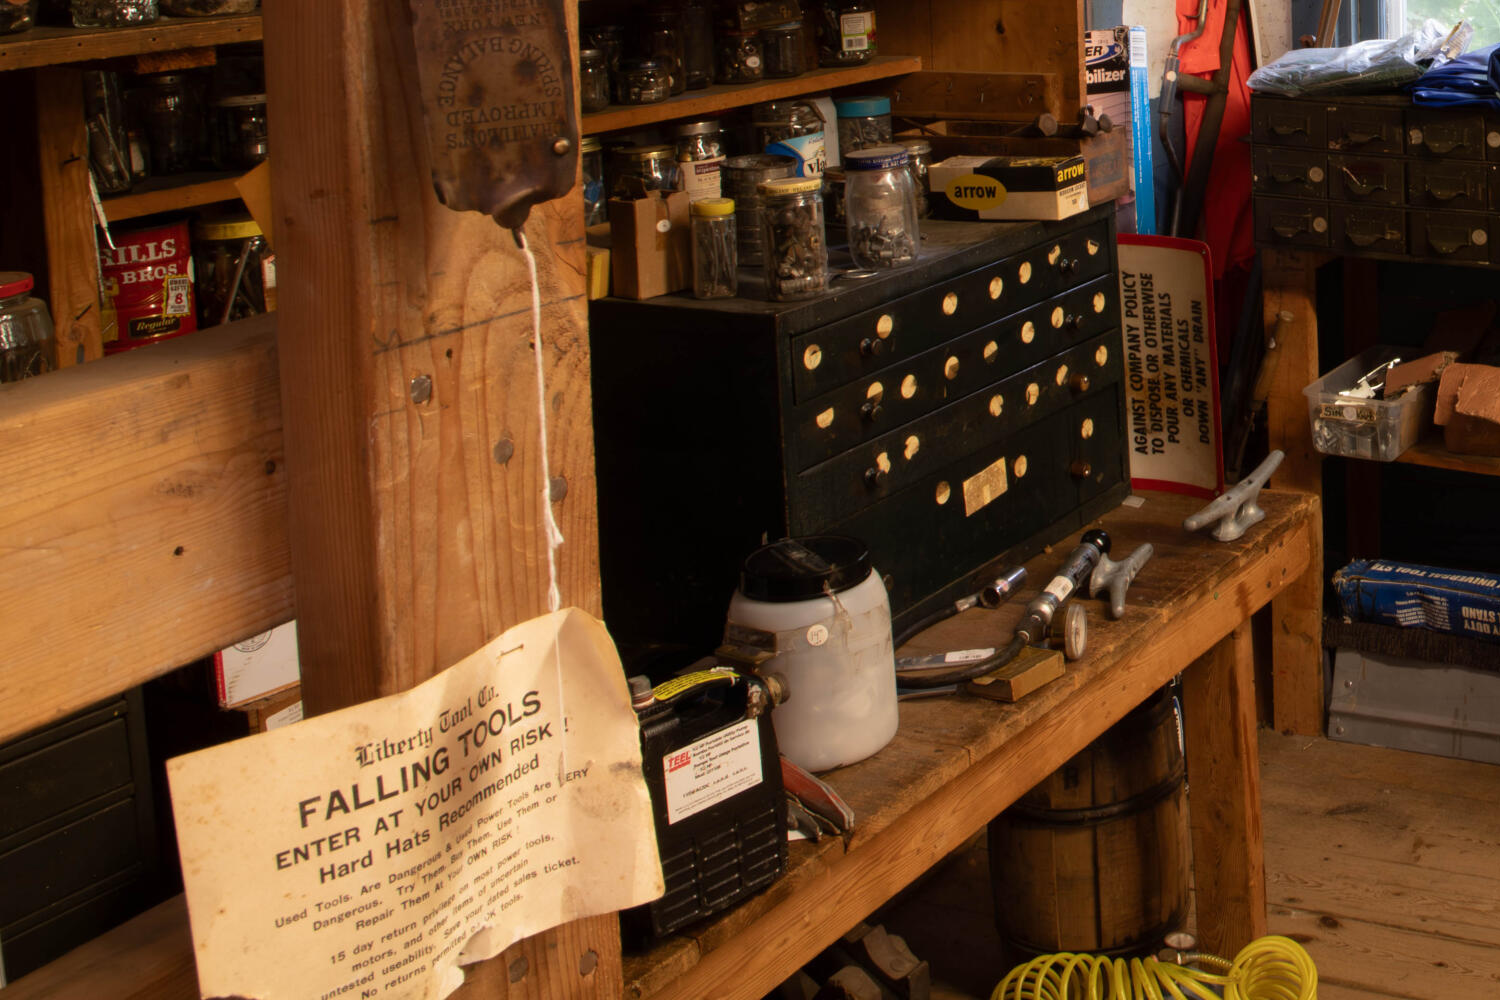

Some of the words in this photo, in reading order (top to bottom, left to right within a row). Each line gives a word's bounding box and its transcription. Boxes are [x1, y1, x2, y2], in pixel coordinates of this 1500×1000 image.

[439, 36, 504, 107] BALANCE
[510, 38, 561, 97] SPRING
[446, 101, 555, 127] IMPROVED
[954, 185, 997, 198] arrow
[1057, 162, 1085, 183] arrow
[121, 264, 178, 284] BROS
[1121, 271, 1138, 320] POLICY
[136, 318, 176, 331] Regular
[1140, 272, 1158, 352] OTHERWISE
[1158, 293, 1176, 367] MATERIALS
[1191, 300, 1204, 343] DRAIN
[1126, 324, 1144, 392] COMPANY
[1146, 354, 1159, 375] OR
[1177, 319, 1194, 393] CHEMICALS
[1194, 350, 1208, 394] "ANY"
[1147, 377, 1164, 432] DISPOSE
[1162, 371, 1179, 401] ANY
[1182, 397, 1195, 418] OR
[1130, 398, 1149, 455] AGAINST
[1152, 436, 1165, 455] TO
[1165, 406, 1181, 445] POUR
[1197, 404, 1210, 445] DOWN
[1395, 566, 1427, 577] TOOL
[1428, 572, 1498, 588] UNIVERSAL
[1461, 606, 1496, 622] STAND
[1464, 619, 1491, 634] DUTY
[299, 747, 450, 828] FALLING
[457, 691, 542, 757] TOOLS
[354, 726, 434, 769] Liberty
[439, 699, 472, 733] Tool
[668, 750, 691, 768] TEEL
[275, 827, 360, 871] ENTER
[374, 810, 404, 836] AT
[415, 777, 462, 817] YOUR
[469, 752, 502, 783] OWN
[510, 722, 553, 755] RISK
[563, 717, 569, 733] !
[319, 850, 373, 884] Hard
[386, 829, 430, 859] Hats
[439, 753, 540, 832] Recommended
[275, 909, 307, 929] Used
[360, 881, 381, 896] Are
[388, 852, 442, 884] Dangerous
[445, 842, 452, 853] &
[456, 825, 473, 845] Used
[476, 808, 503, 829] Power
[507, 791, 529, 808] Tools
[533, 781, 552, 792] Are
[557, 768, 589, 788] ERY
[313, 899, 383, 931] Dangerous.
[397, 882, 415, 896] Try
[451, 851, 463, 865] Buy
[497, 817, 512, 831] Use
[517, 801, 539, 818] Them
[545, 794, 557, 804] or
[331, 950, 346, 964] 15
[353, 941, 374, 957] day
[381, 922, 417, 942] return
[422, 894, 456, 925] privilege
[459, 883, 469, 894] on
[474, 867, 494, 885] most
[497, 848, 521, 870] power
[355, 907, 395, 931] Repair
[401, 892, 430, 911] Them
[434, 881, 443, 893] At
[447, 865, 463, 882] Your
[467, 849, 487, 866] OWN
[492, 833, 513, 850] RISK
[404, 933, 423, 949] and
[428, 915, 449, 936] other
[453, 895, 474, 915] items
[478, 886, 487, 896] of
[490, 859, 529, 888] uncertain
[321, 972, 375, 1000] untested
[443, 920, 461, 939] Save
[465, 904, 483, 922] your
[487, 886, 509, 906] dated
[514, 871, 537, 888] sales
[544, 856, 581, 874] ticket.
[361, 987, 378, 1000] No
[385, 964, 427, 988] returns
[432, 933, 467, 966] permitted
